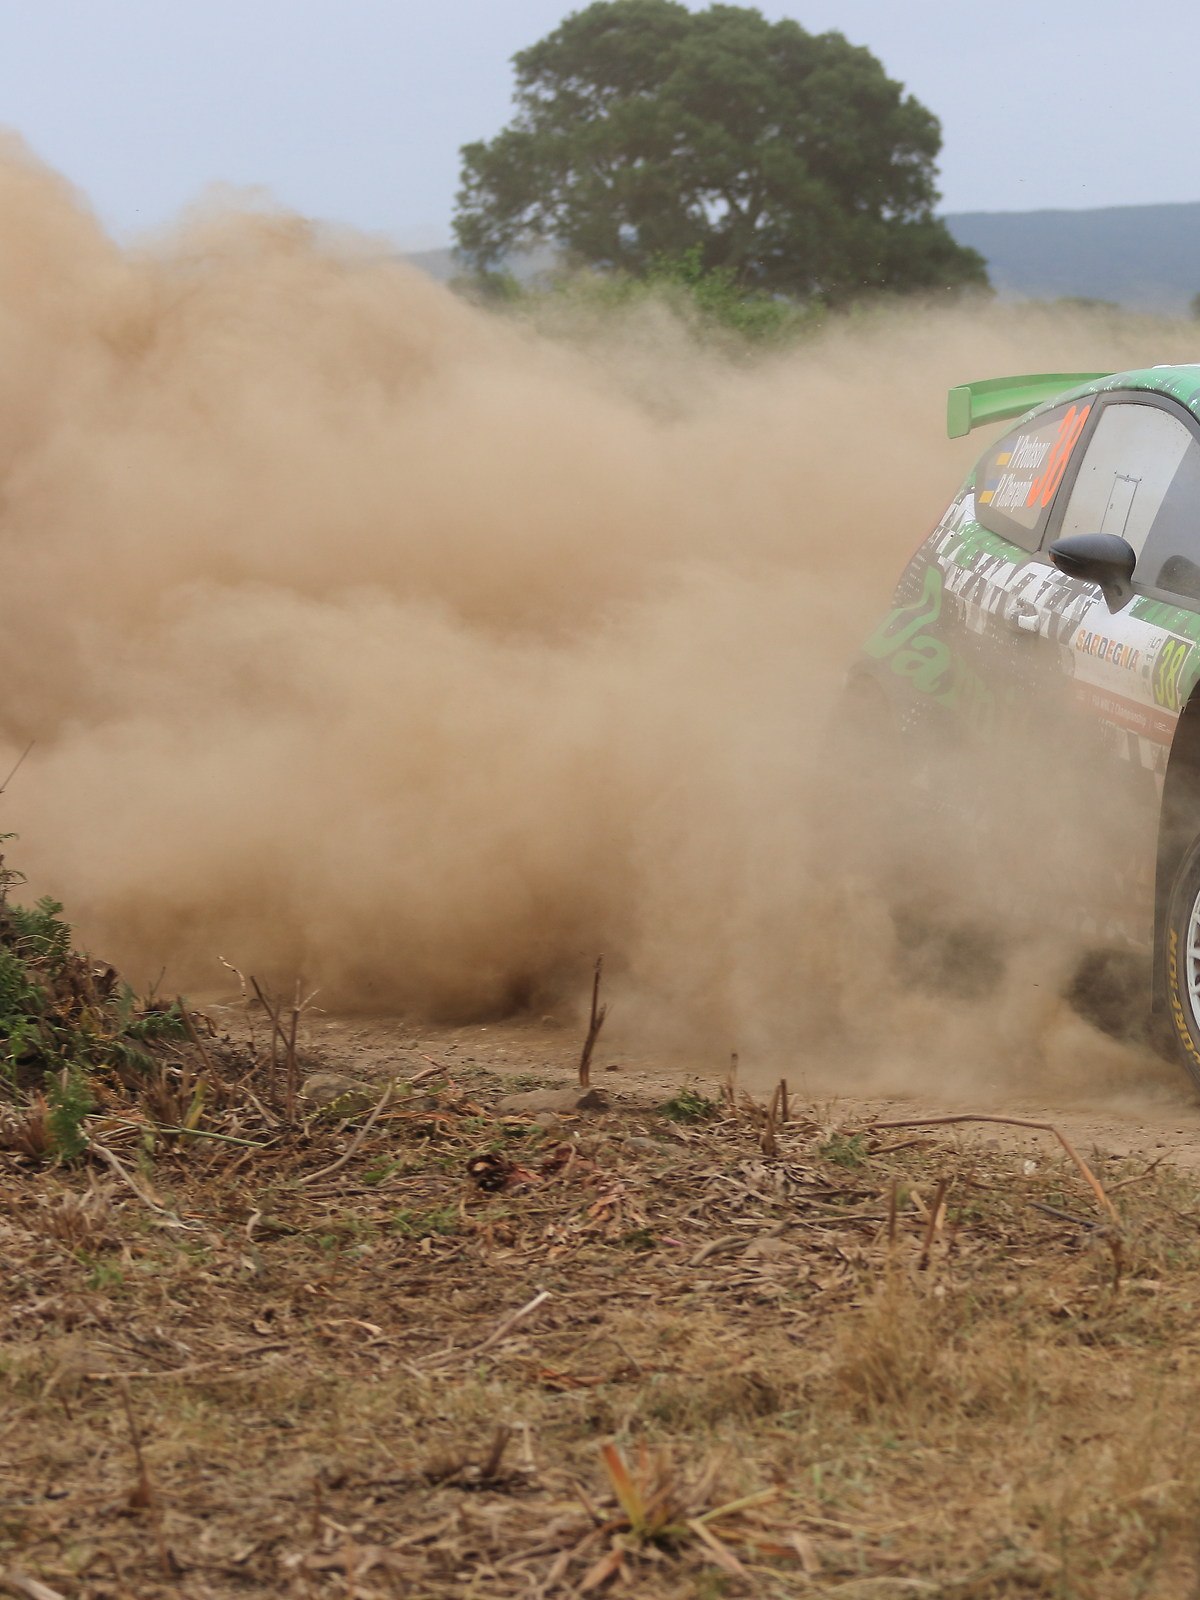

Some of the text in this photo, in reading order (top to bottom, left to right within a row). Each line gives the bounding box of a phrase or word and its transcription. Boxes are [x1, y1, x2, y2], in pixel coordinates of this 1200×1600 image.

[1026, 405, 1091, 507] 38
[1075, 630, 1139, 673] SARDEGNA
[1155, 639, 1187, 709] 38
